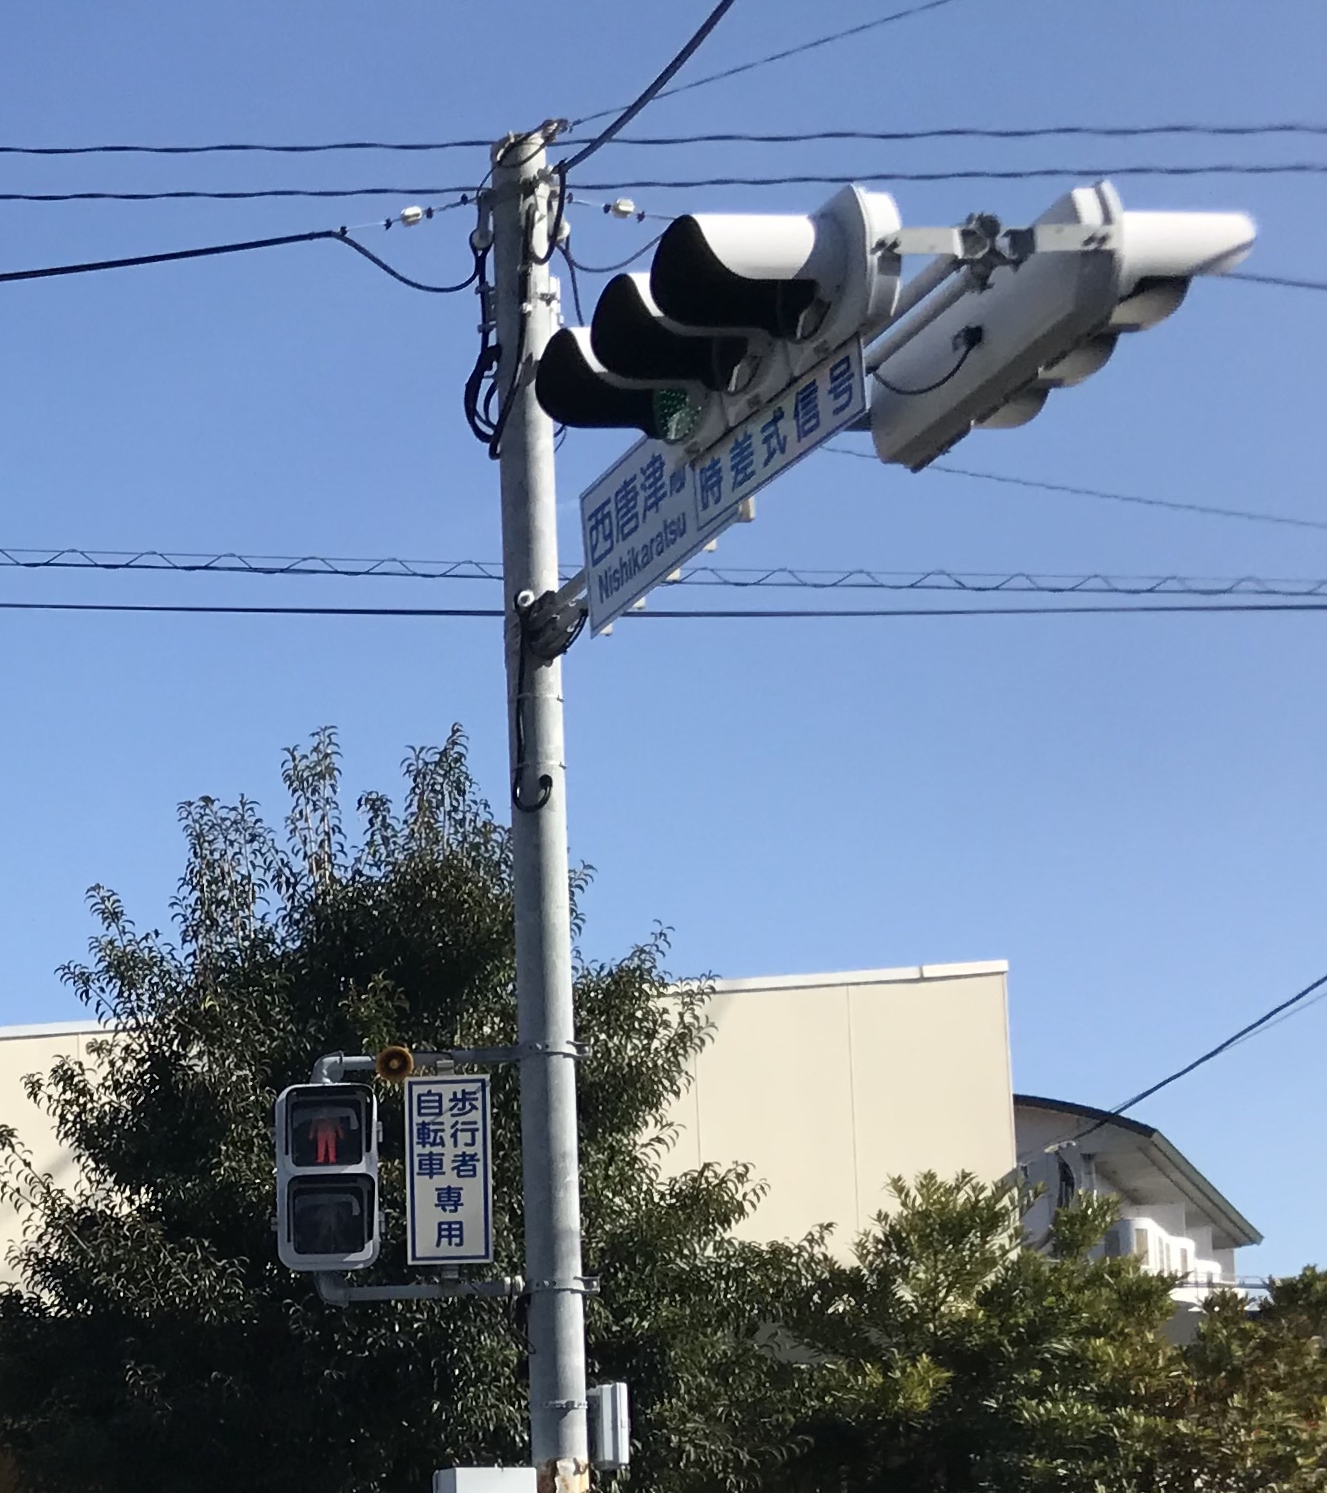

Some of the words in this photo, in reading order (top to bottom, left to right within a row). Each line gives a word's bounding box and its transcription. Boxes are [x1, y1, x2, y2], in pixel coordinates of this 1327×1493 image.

[699, 354, 855, 511] 時差式信号
[598, 511, 687, 604] Nishikaratsu
[415, 1089, 446, 1180] 自転車
[448, 1088, 481, 1180] 歩行者
[434, 1184, 465, 1248] 専用
